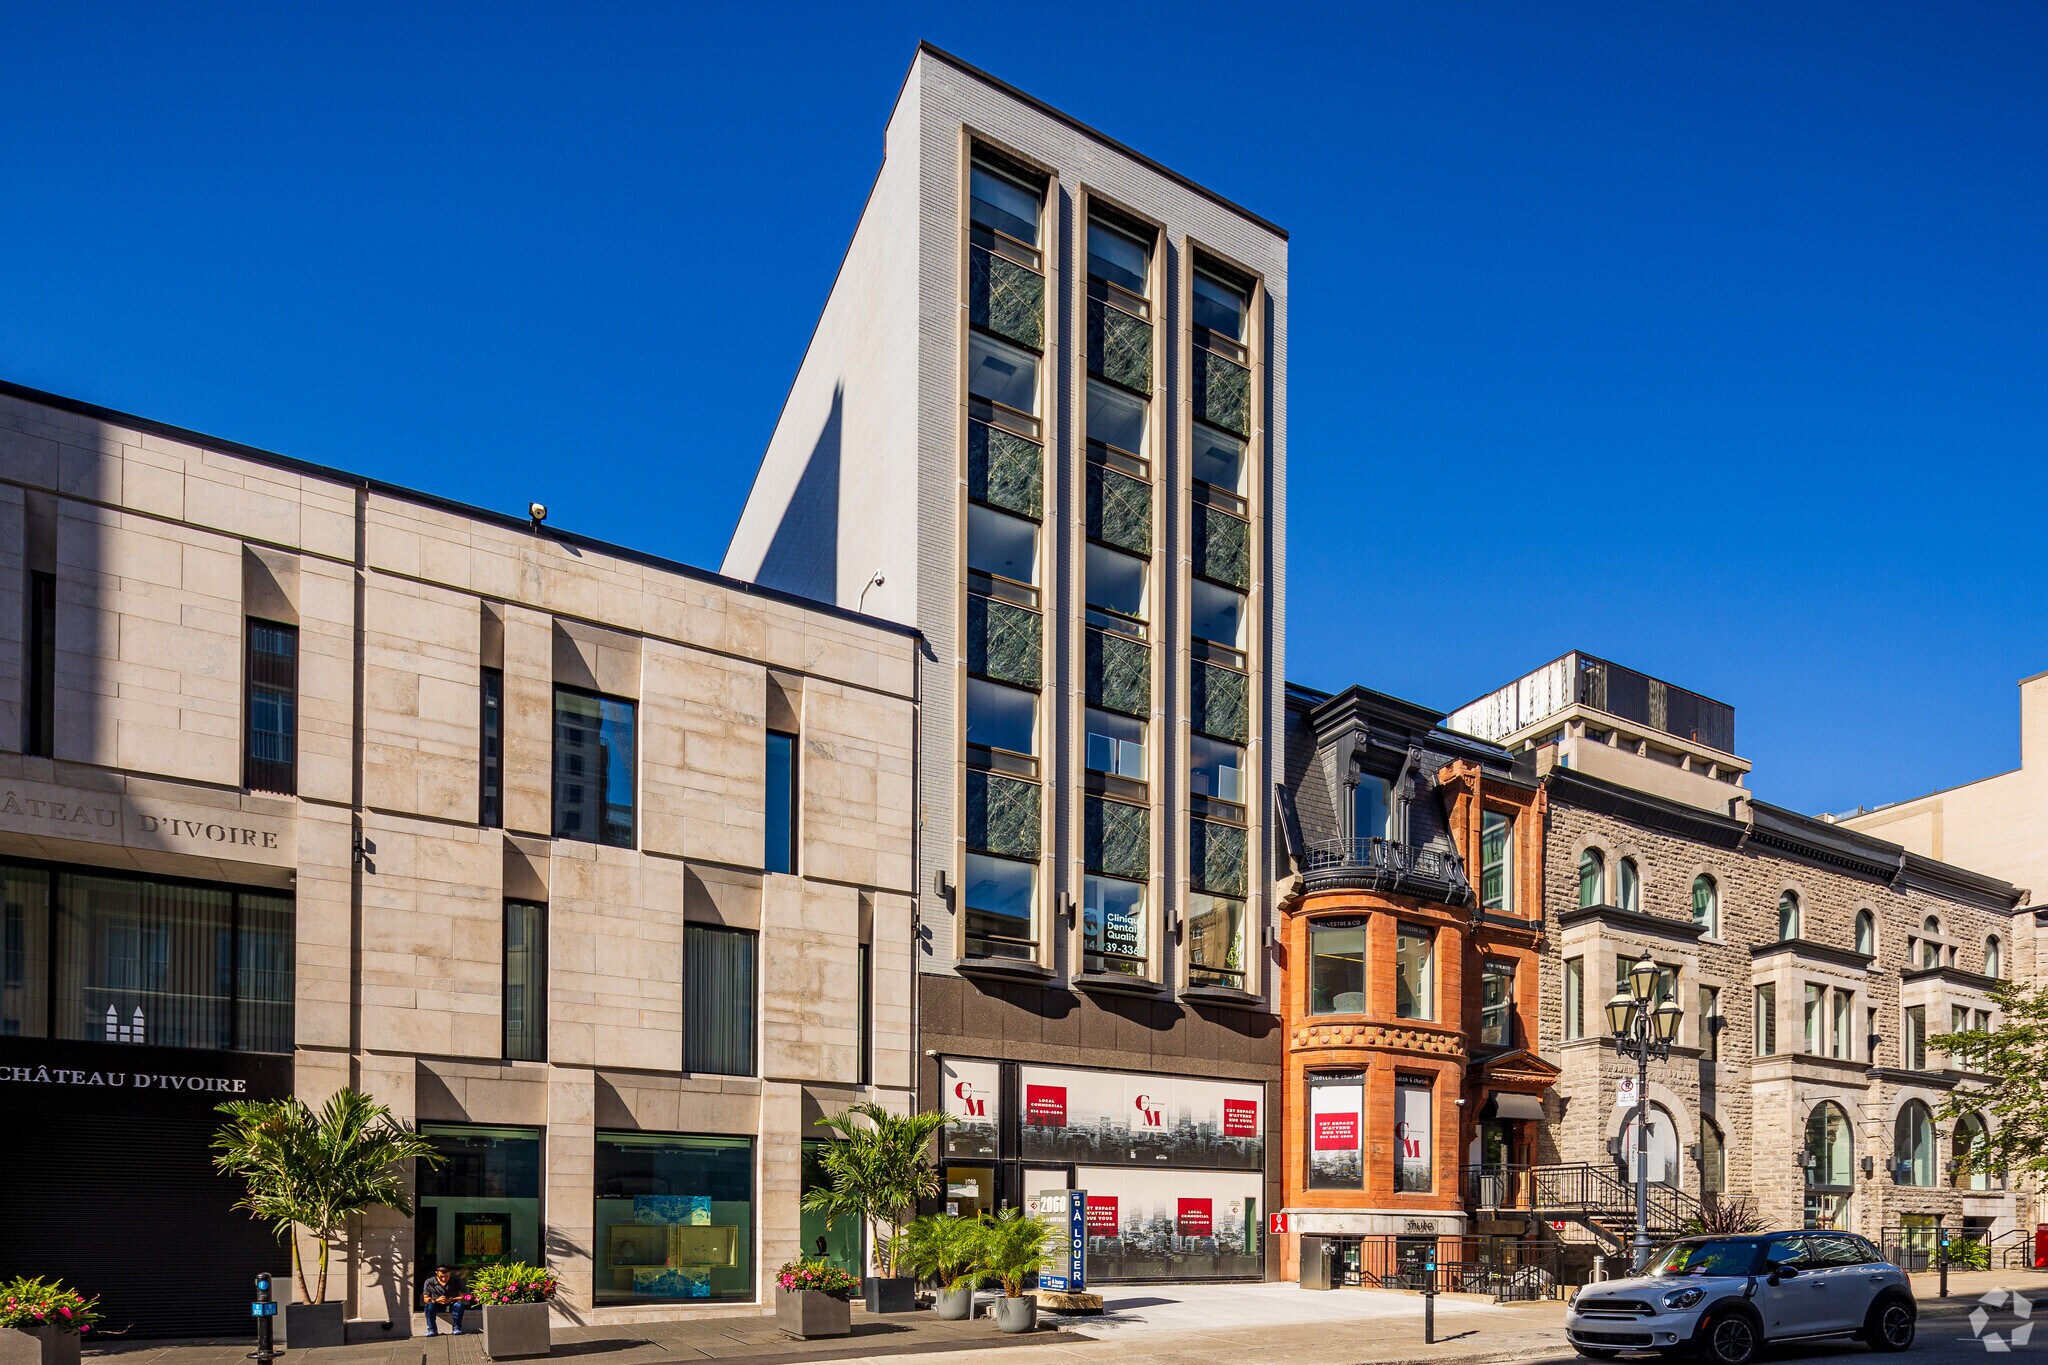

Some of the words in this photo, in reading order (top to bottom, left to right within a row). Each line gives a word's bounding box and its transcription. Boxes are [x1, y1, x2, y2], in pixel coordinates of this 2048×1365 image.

[139, 814, 278, 849] D'IVOIRE
[0, 1064, 125, 1087] CHÂTEAU
[133, 1073, 246, 1093] D'IVOIRE
[1040, 1195, 1066, 1213] 2060
[1073, 1209, 1082, 1221] À
[1073, 1228, 1082, 1281] LOUER
